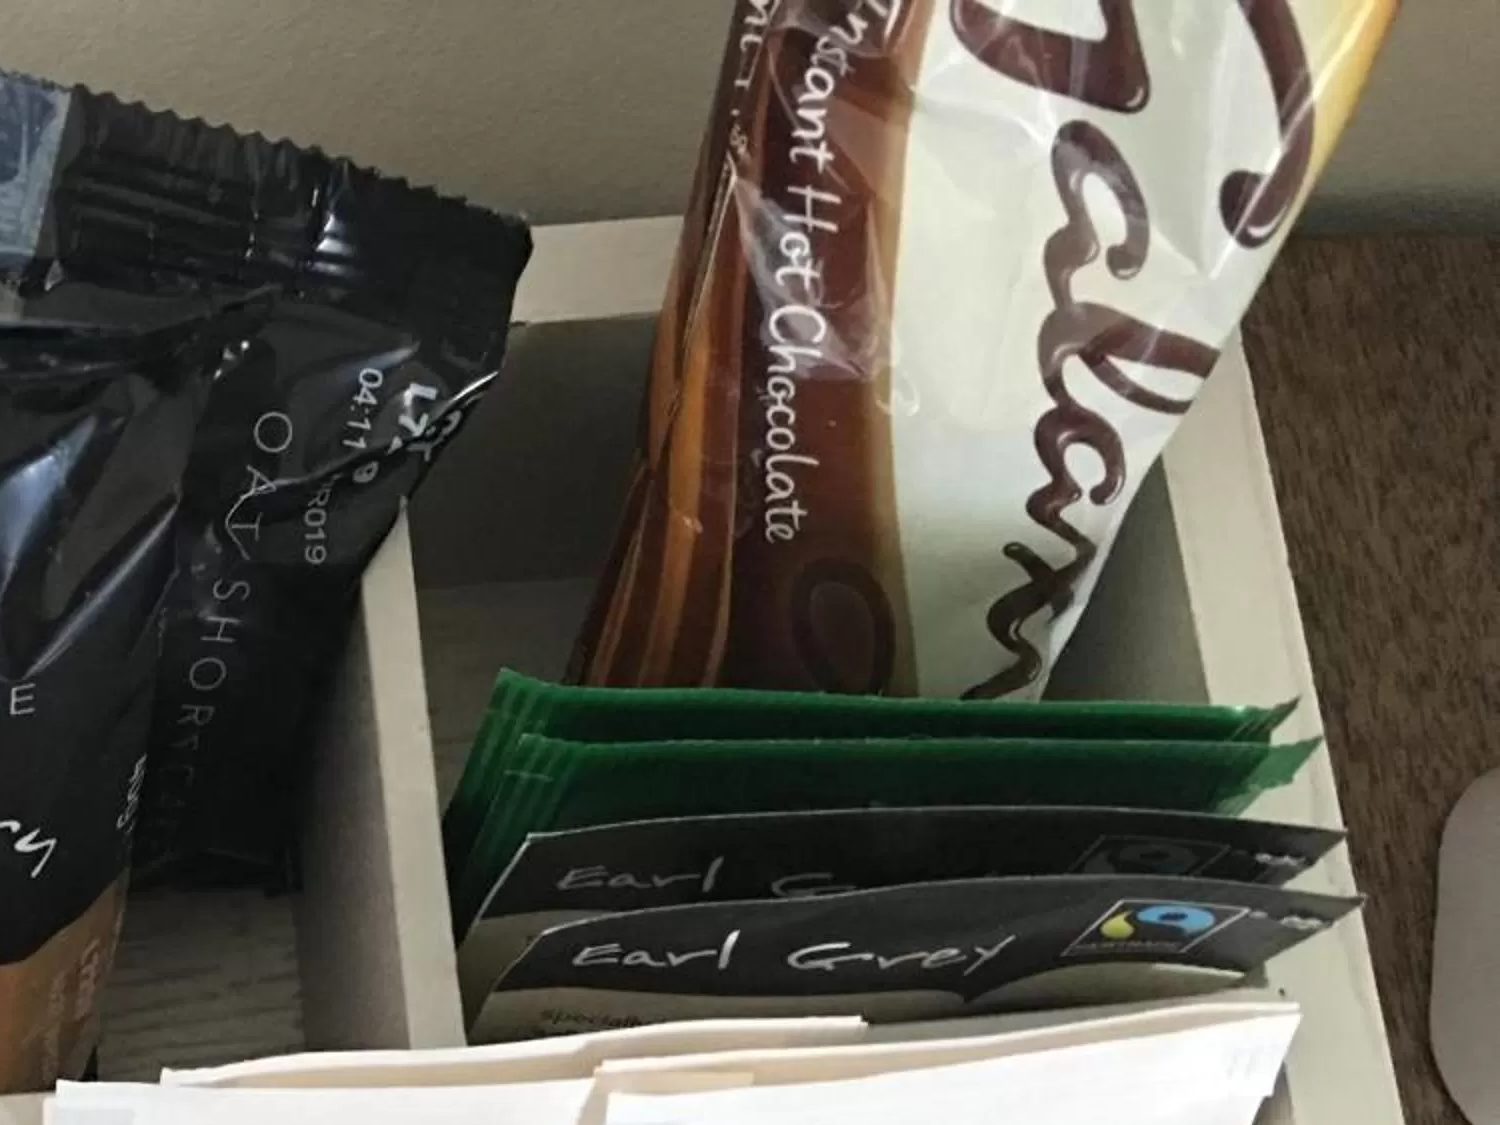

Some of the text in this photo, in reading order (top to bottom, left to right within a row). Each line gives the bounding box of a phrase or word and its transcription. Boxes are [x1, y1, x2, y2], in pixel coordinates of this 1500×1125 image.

[775, 186, 841, 289] Hot
[763, 304, 827, 543] Chocolate
[557, 856, 725, 893] Earl
[572, 929, 1016, 976] Earl Grey
